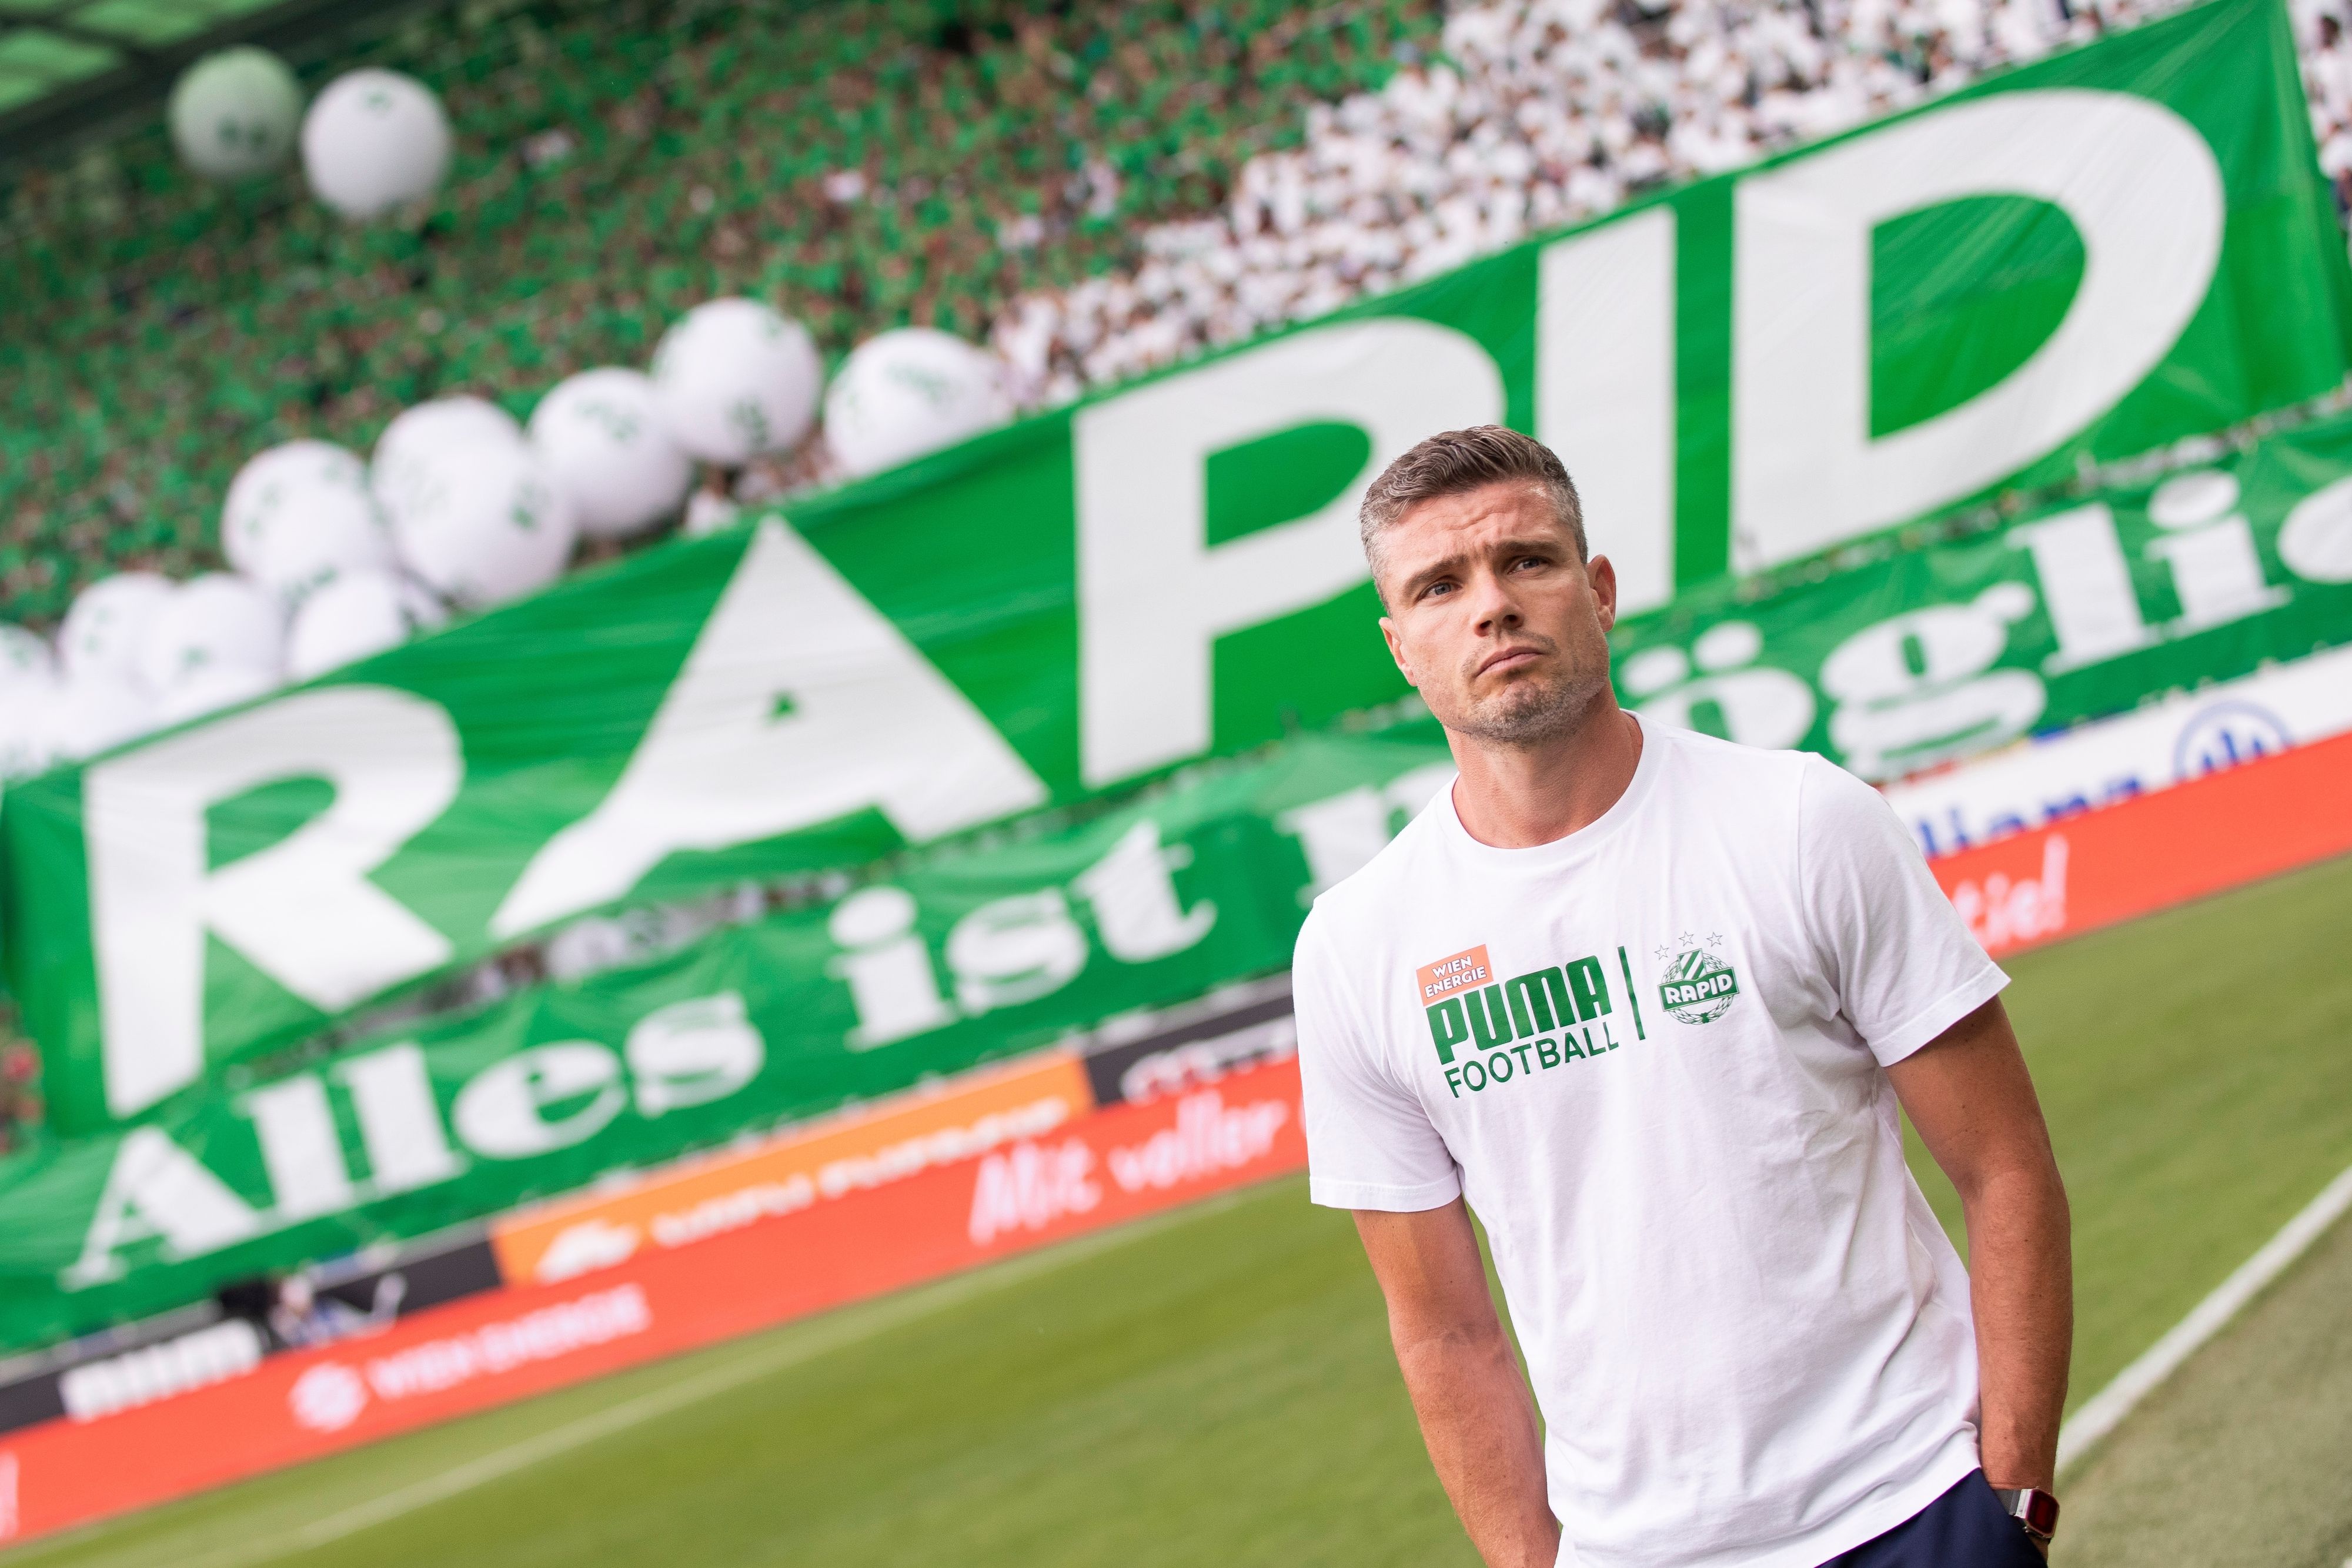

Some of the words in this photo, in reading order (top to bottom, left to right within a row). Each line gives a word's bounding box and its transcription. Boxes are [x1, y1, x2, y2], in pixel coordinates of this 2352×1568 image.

[84, 88, 2226, 1117] RAPID
[1424, 965, 1486, 999] ENERGIE
[1431, 955, 1473, 979] WIEN
[1663, 973, 1733, 1005] RAPID
[1425, 955, 1612, 1065] PUMA
[61, 991, 766, 1290] Alles
[828, 819, 1216, 1051] ist
[1444, 1021, 1619, 1098] FOOTBALL
